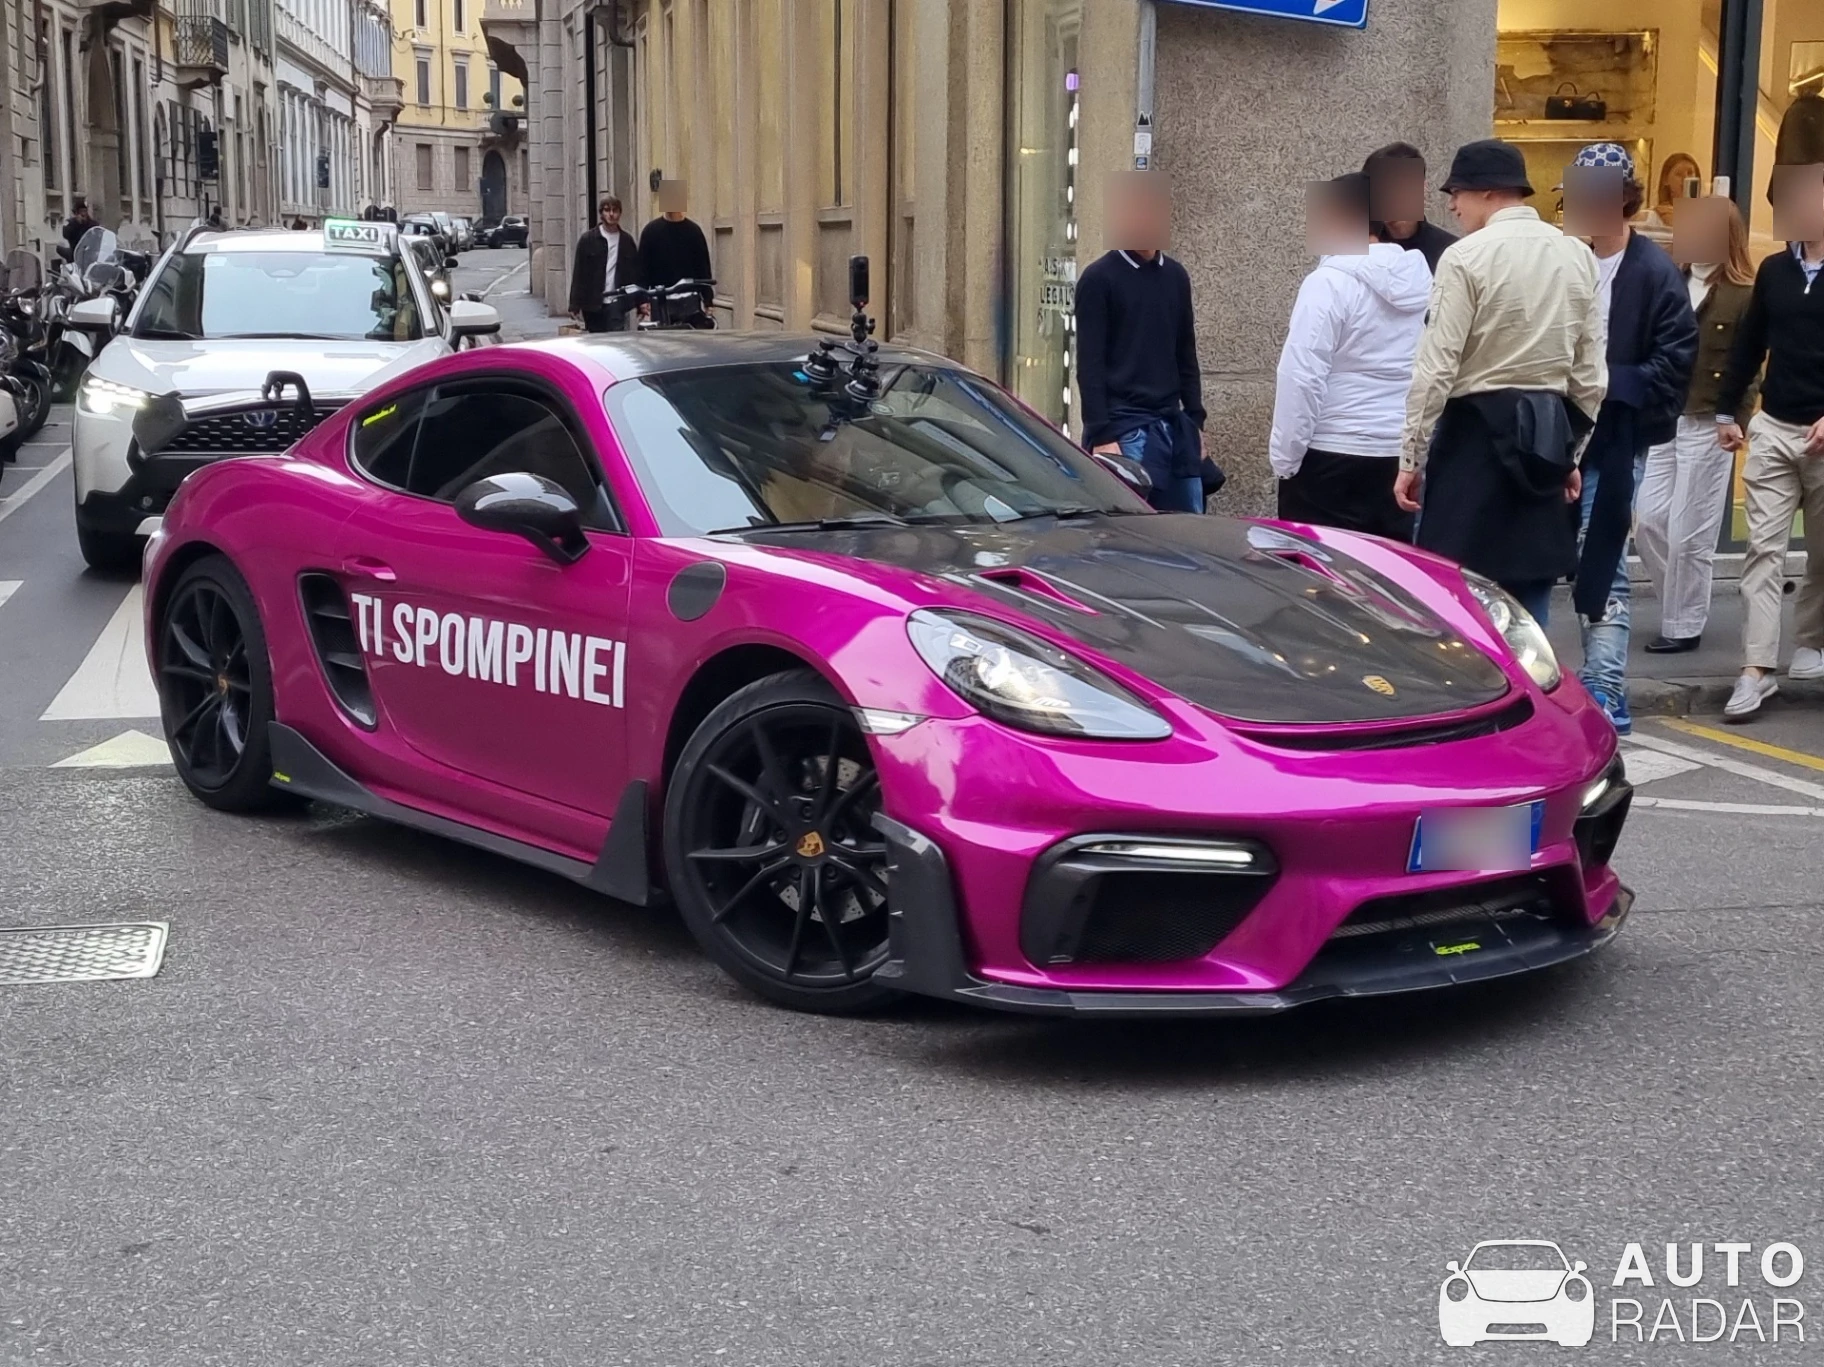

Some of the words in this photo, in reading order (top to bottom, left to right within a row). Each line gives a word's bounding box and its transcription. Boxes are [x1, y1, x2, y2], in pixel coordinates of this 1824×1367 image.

[331, 226, 375, 240] TAXI
[351, 593, 383, 656] TI
[392, 603, 626, 708] SPOMPINEI
